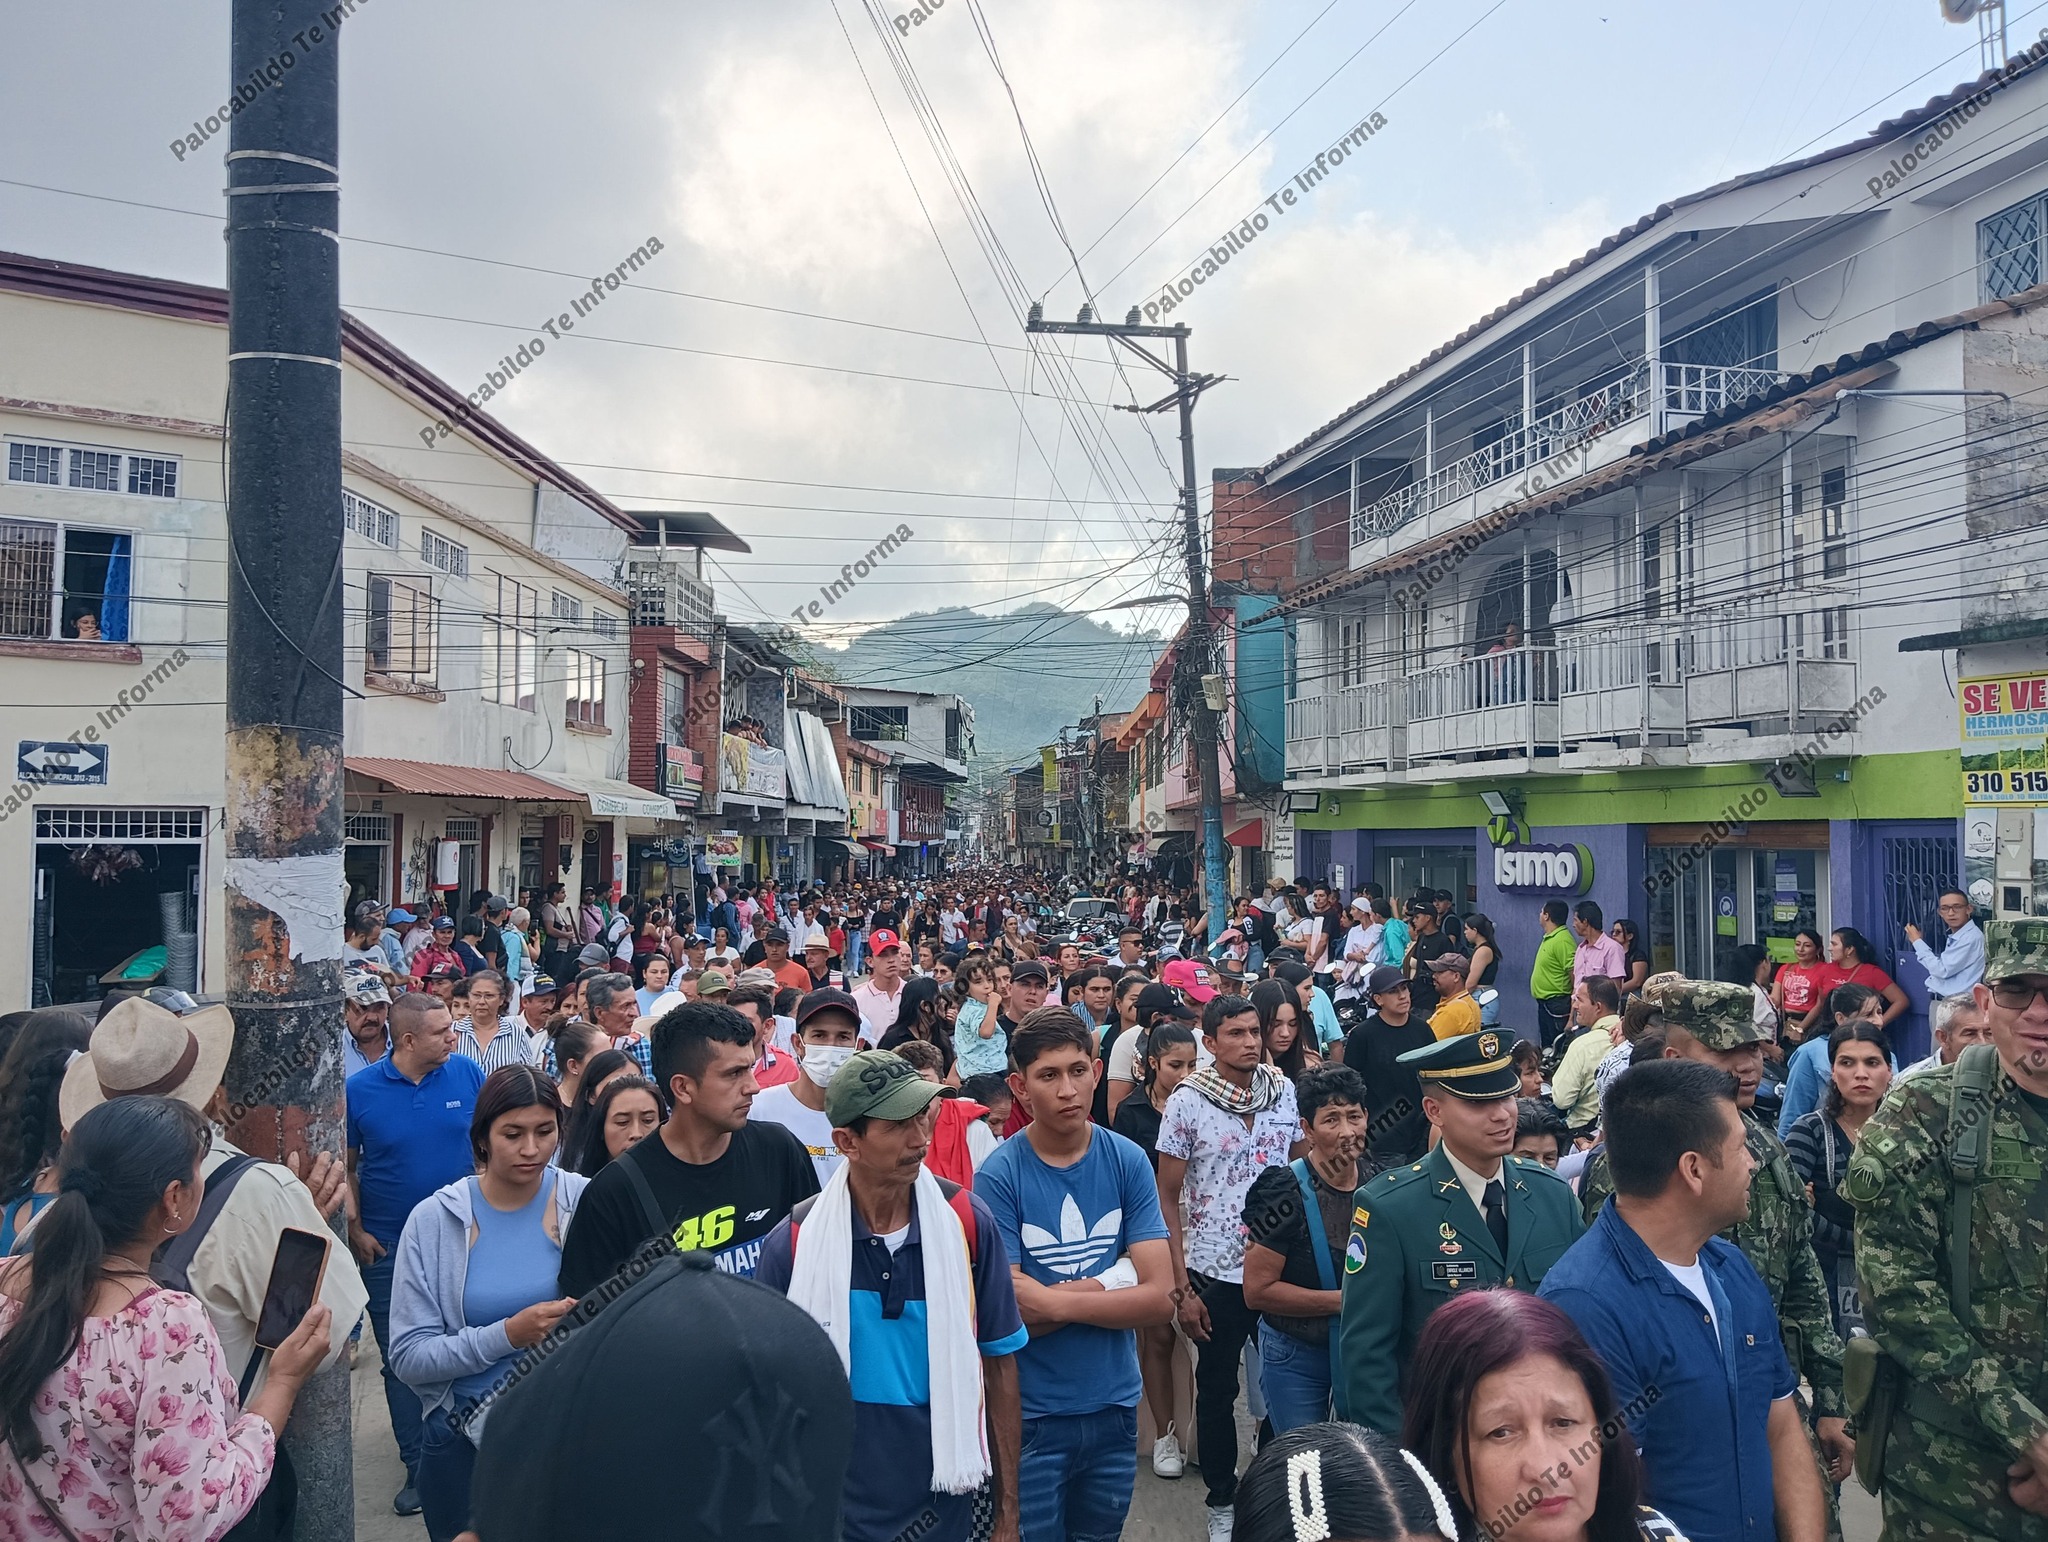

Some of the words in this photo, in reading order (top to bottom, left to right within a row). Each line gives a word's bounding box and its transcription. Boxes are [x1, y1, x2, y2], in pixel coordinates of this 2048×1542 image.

[1963, 683, 2000, 715] SE
[1966, 712, 2048, 729] HERMOSA
[1973, 728, 2013, 737] HECTAREAS
[2016, 726, 2044, 735] VEREDA
[1968, 772, 2002, 793] 310
[2011, 771, 2048, 792] 515
[673, 1205, 736, 1252] 46
